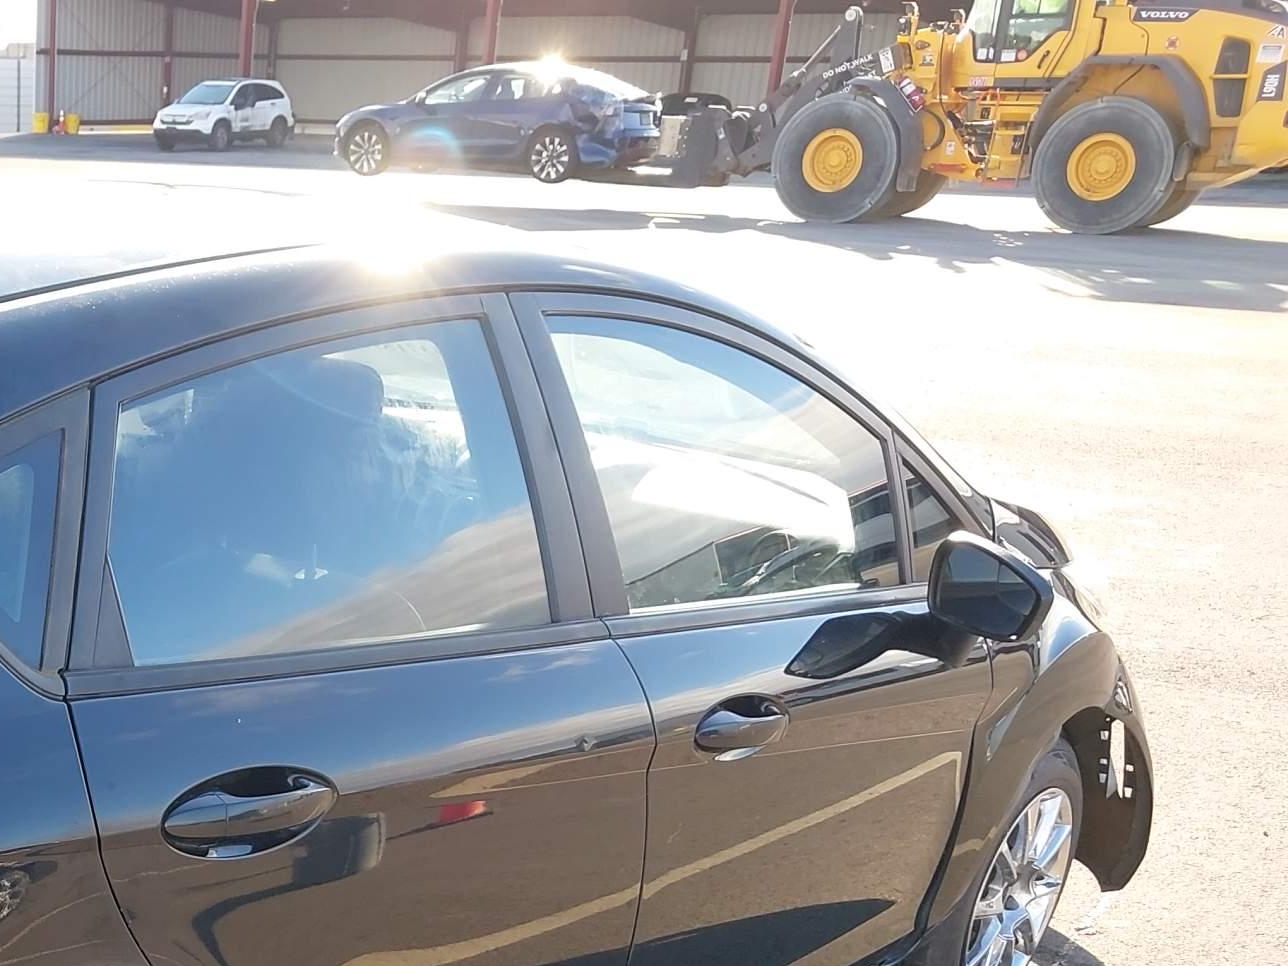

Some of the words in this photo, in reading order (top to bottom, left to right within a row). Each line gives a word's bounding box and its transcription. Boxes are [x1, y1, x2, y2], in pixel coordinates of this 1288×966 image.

[1140, 11, 1189, 19] VOLVO
[822, 69, 835, 79] DO
[834, 61, 851, 75] NOT
